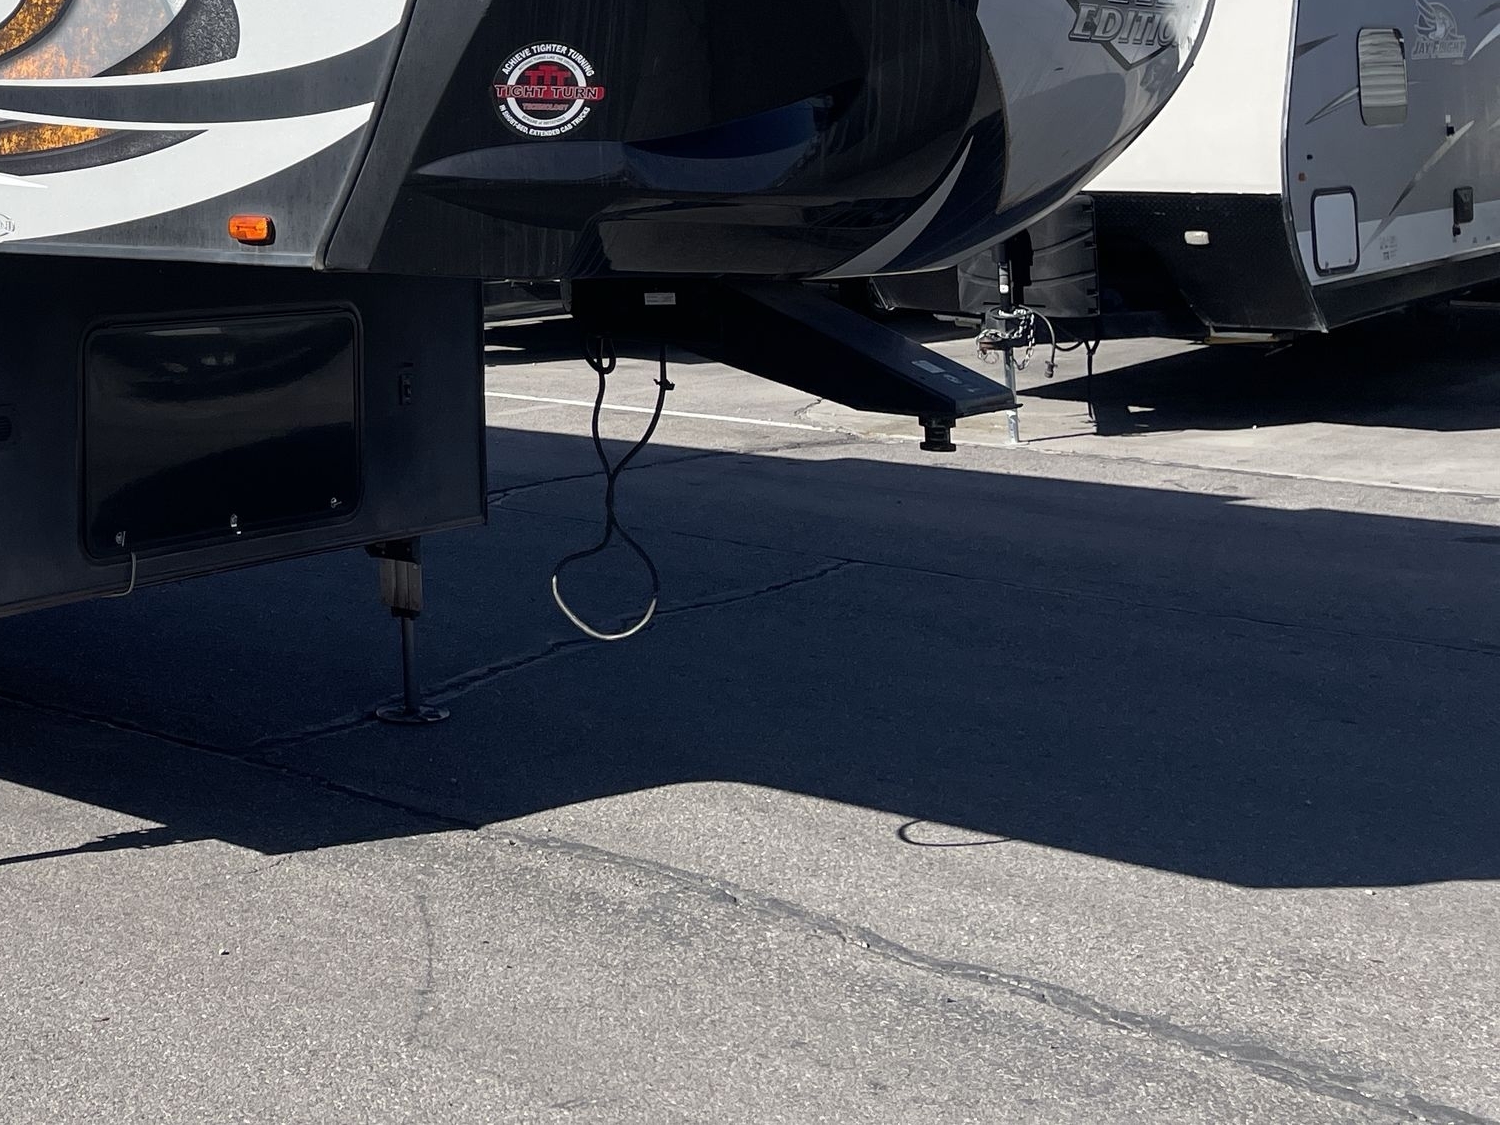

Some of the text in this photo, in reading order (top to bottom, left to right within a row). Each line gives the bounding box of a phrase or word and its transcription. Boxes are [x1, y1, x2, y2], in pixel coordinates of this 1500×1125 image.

[1068, 2, 1188, 49] EDITIO
[502, 43, 595, 77] ACHIEVE TIGHTER TURNING
[494, 84, 599, 99] TIGHT TURN
[529, 128, 561, 137] EXTENDED
[560, 123, 574, 133] CAB
[570, 106, 591, 127] TRUCKS
